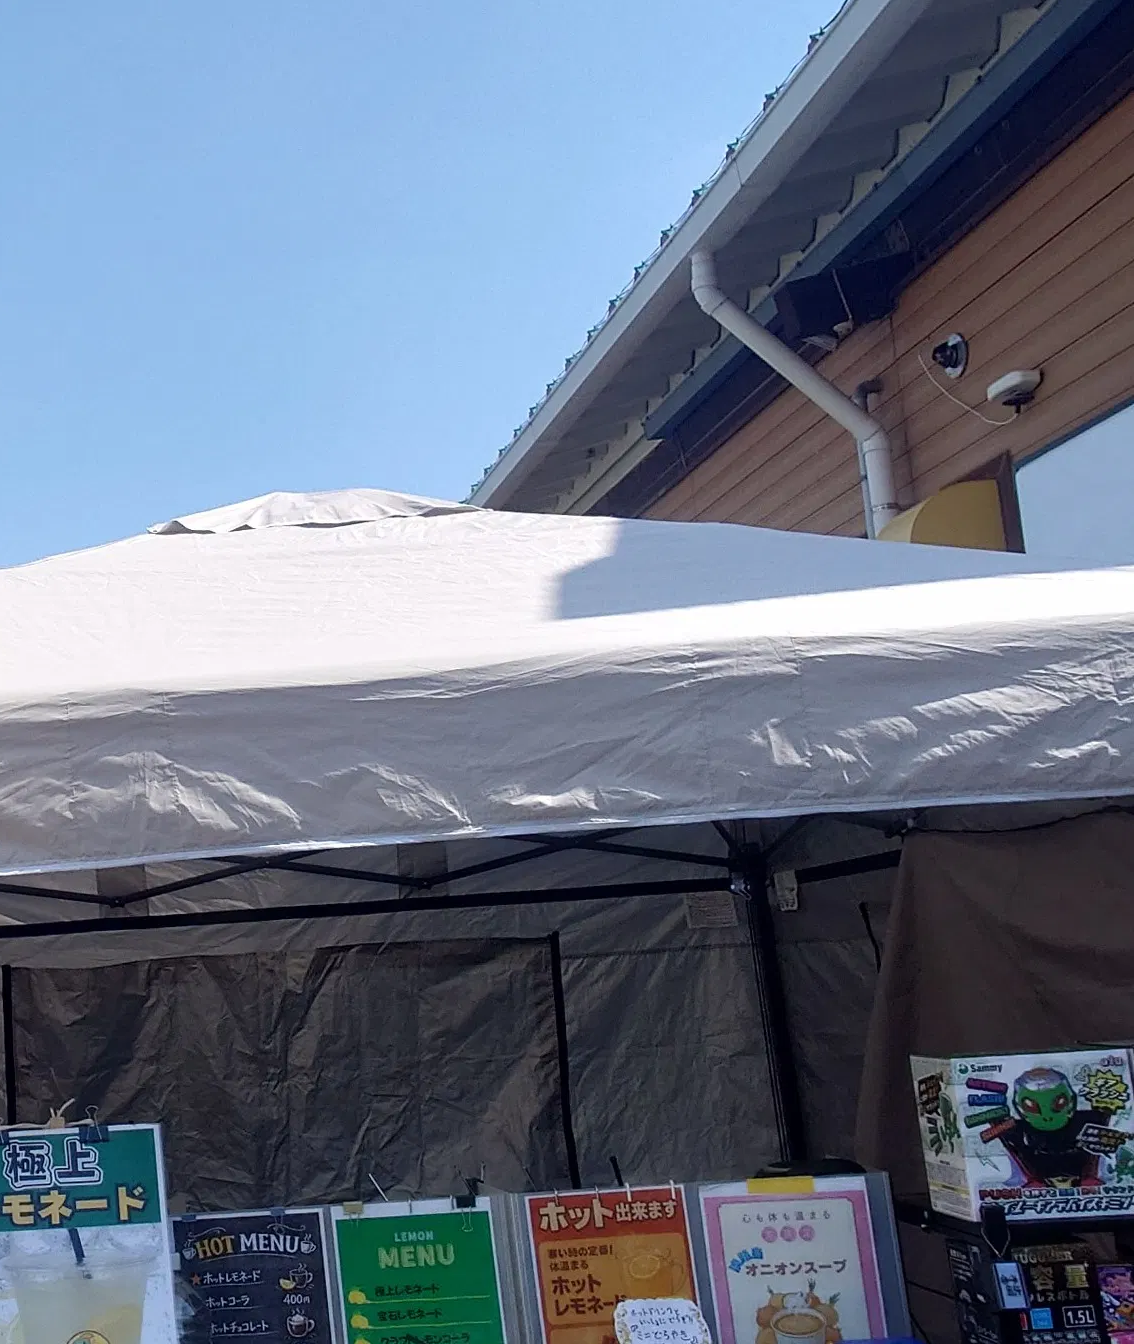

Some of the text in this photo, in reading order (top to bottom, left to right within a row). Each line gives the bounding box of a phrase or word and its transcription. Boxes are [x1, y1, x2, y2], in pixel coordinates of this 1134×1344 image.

[970, 1062, 1003, 1074] Sammy
[4, 1138, 103, 1189] 極上
[394, 1231, 434, 1243] LEMON
[194, 1233, 300, 1259] HOT MENU
[377, 1243, 455, 1269] MENU
[549, 1260, 589, 1273] 体温まる
[745, 1258, 847, 1277] オニオンスープ
[203, 1270, 261, 1284] ホットレモネード
[551, 1274, 602, 1296] ホット
[206, 1294, 251, 1308] ホットコーラ
[1067, 1309, 1095, 1325] 1.5L
